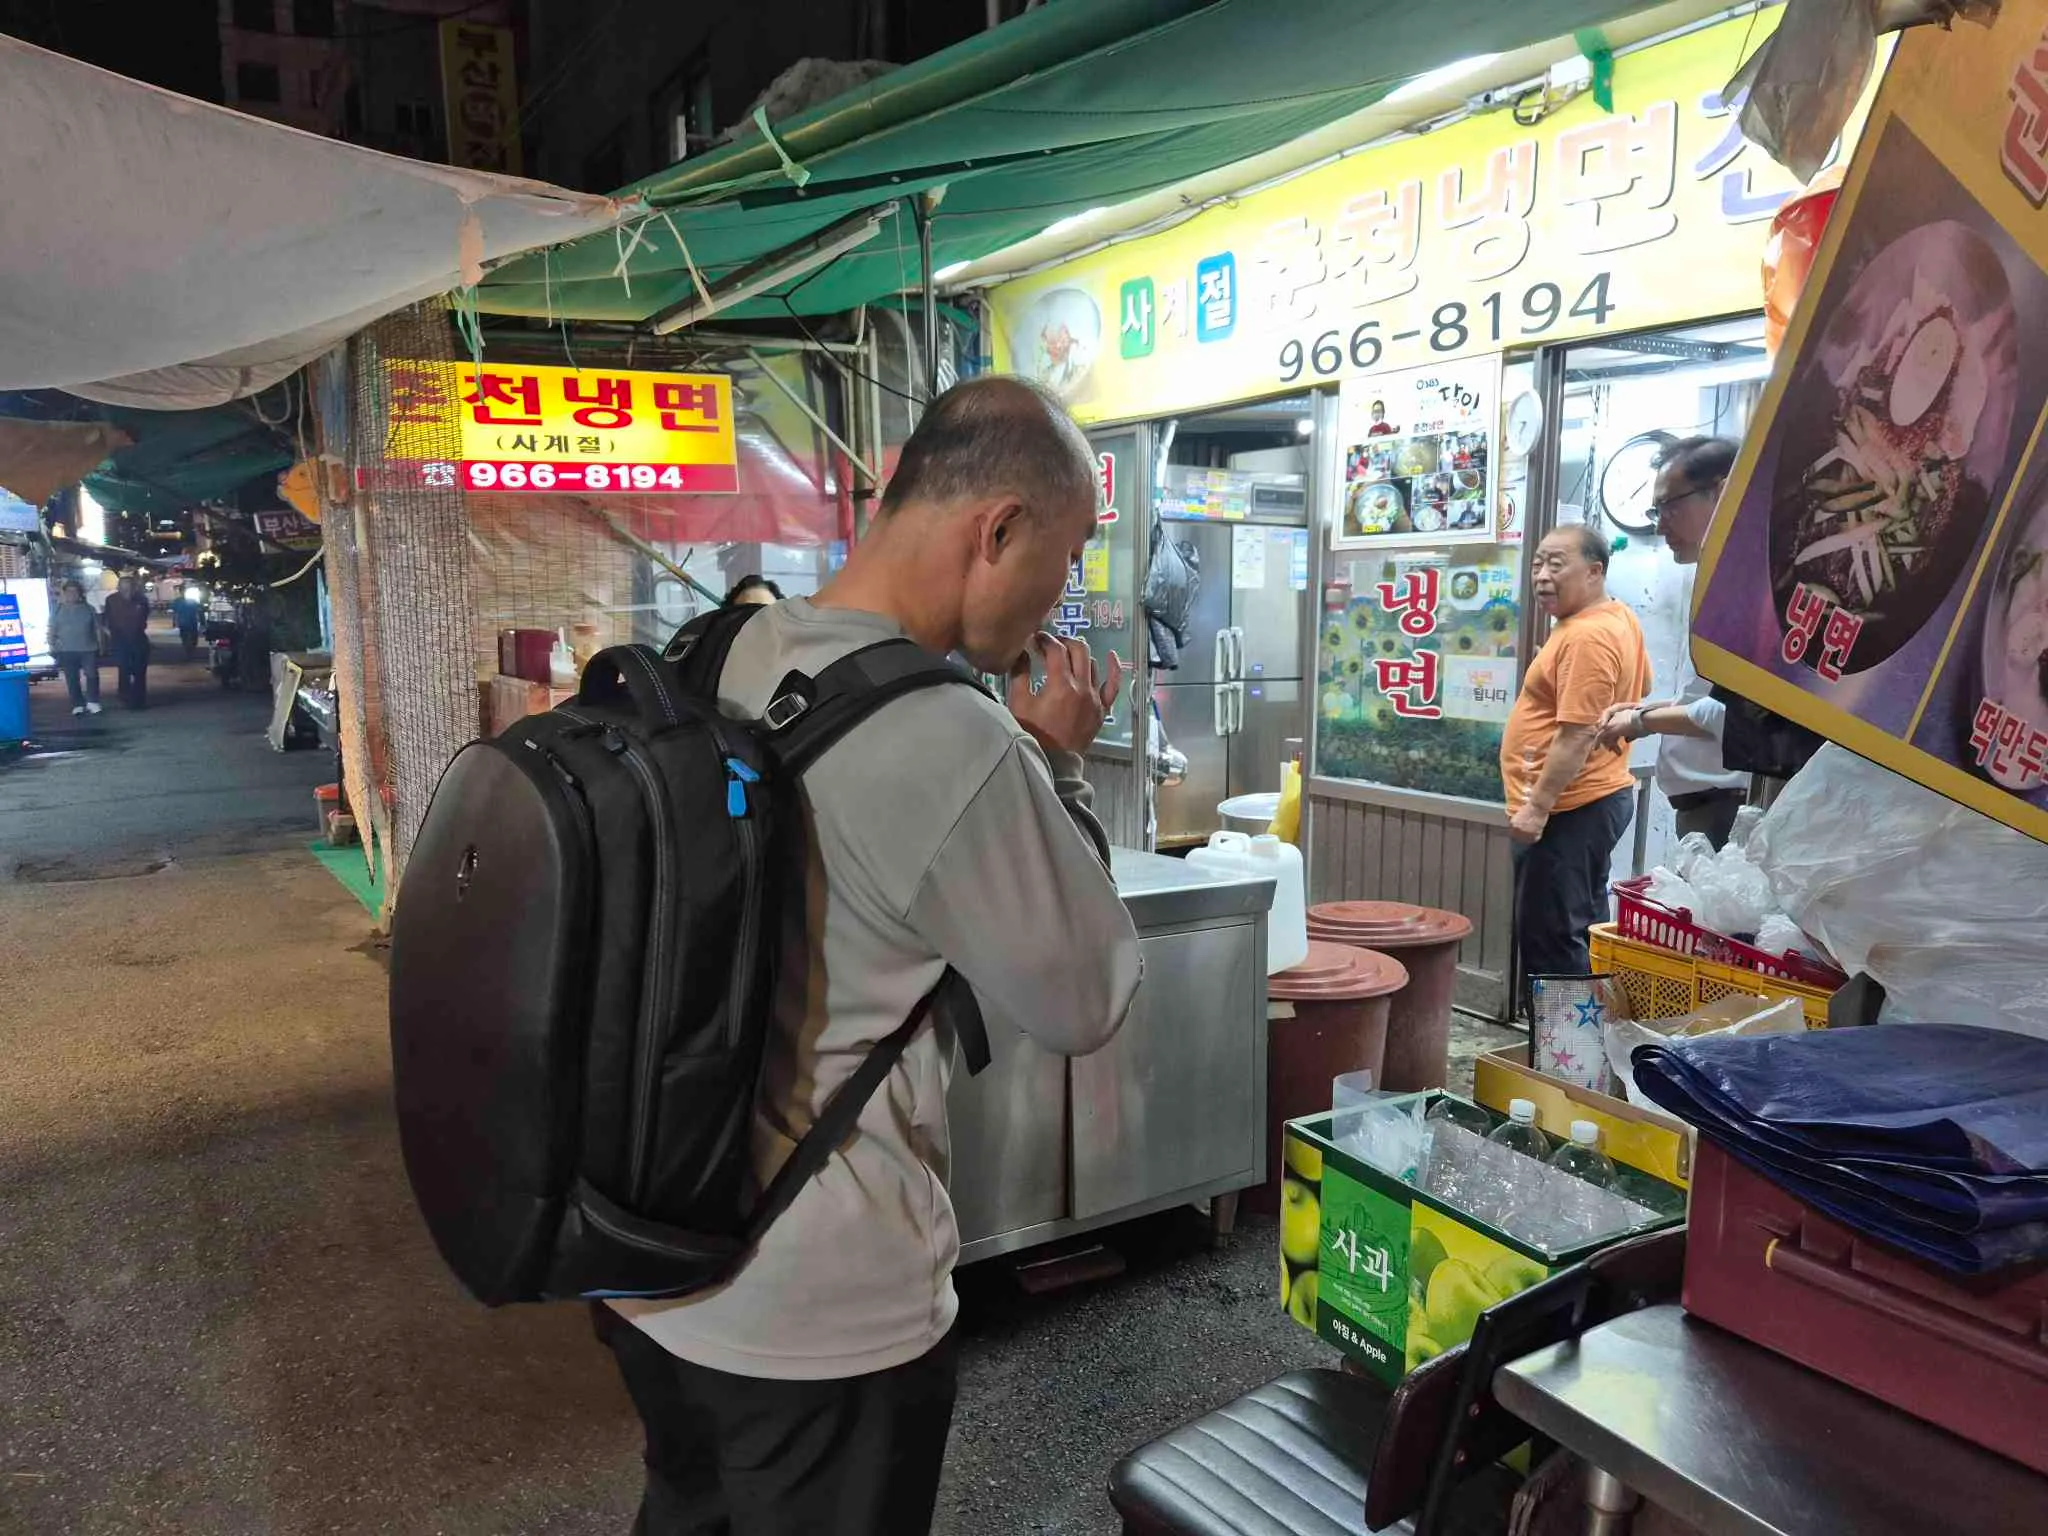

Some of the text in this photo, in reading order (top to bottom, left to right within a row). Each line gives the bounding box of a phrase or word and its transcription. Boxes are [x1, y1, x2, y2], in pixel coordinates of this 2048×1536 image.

[1121, 264, 1233, 347] 사계절
[1252, 101, 1681, 322] 춘천냉면
[1278, 272, 1616, 383] 966-8194
[471, 462, 684, 490] 966-8194
[496, 434, 616, 455] (사계절)
[1372, 566, 1442, 718] 냉면
[1782, 582, 1863, 683] 냉면
[1473, 687, 1508, 703] 됩니다
[1969, 697, 2048, 788] 떡만두
[1331, 1228, 1395, 1293] 사과
[1332, 1318, 1387, 1364] 아침 & Apple
